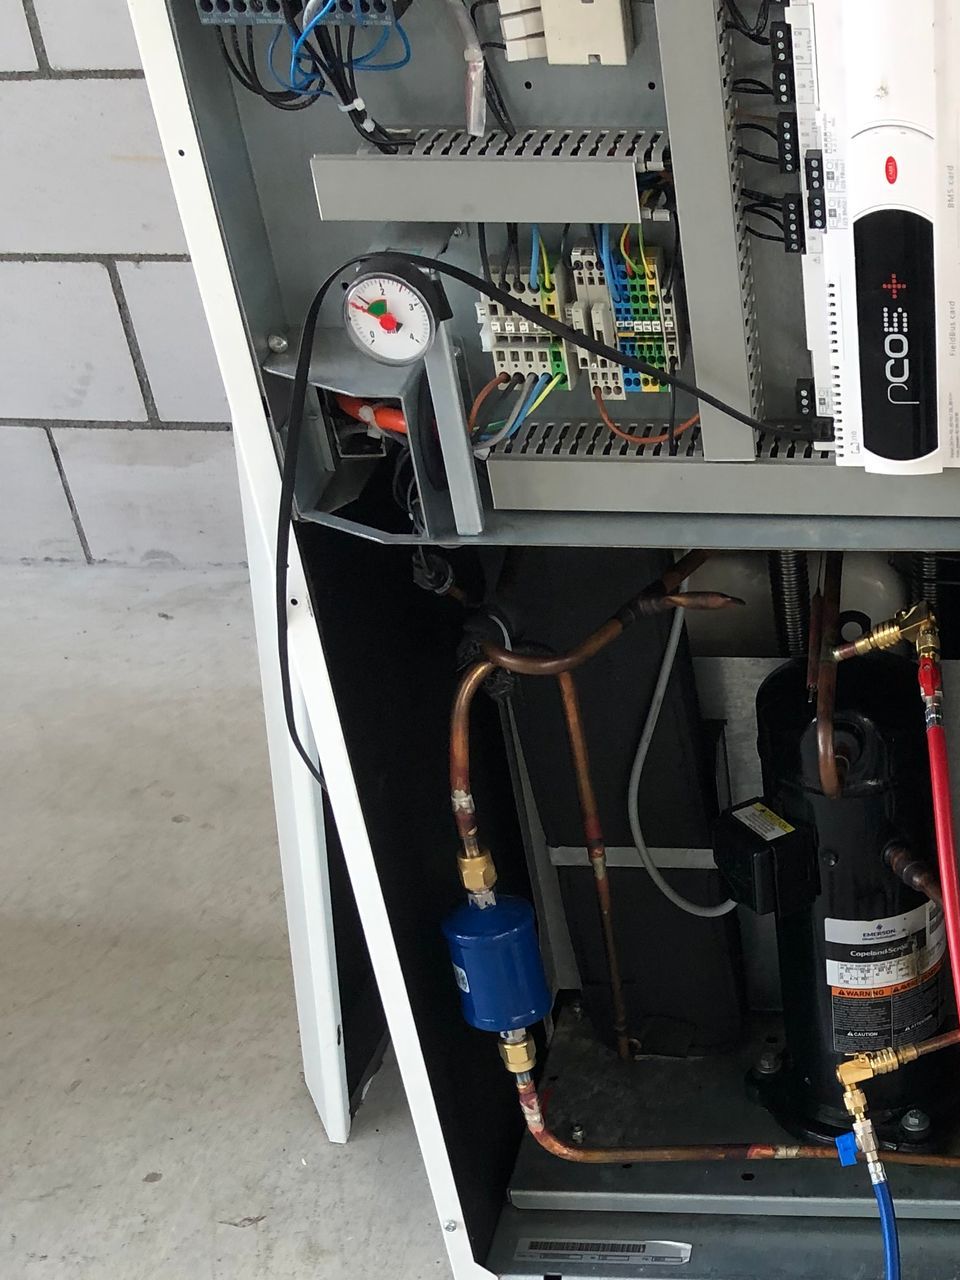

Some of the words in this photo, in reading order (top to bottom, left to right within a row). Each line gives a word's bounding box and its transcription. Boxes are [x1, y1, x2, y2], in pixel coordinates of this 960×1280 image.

[947, 184, 955, 208] BMS
[380, 288, 385, 296] 2
[408, 303, 414, 311] 3
[369, 330, 375, 338] 0
[862, 928, 897, 938] EMERSON
[846, 989, 885, 997] WARNNG
